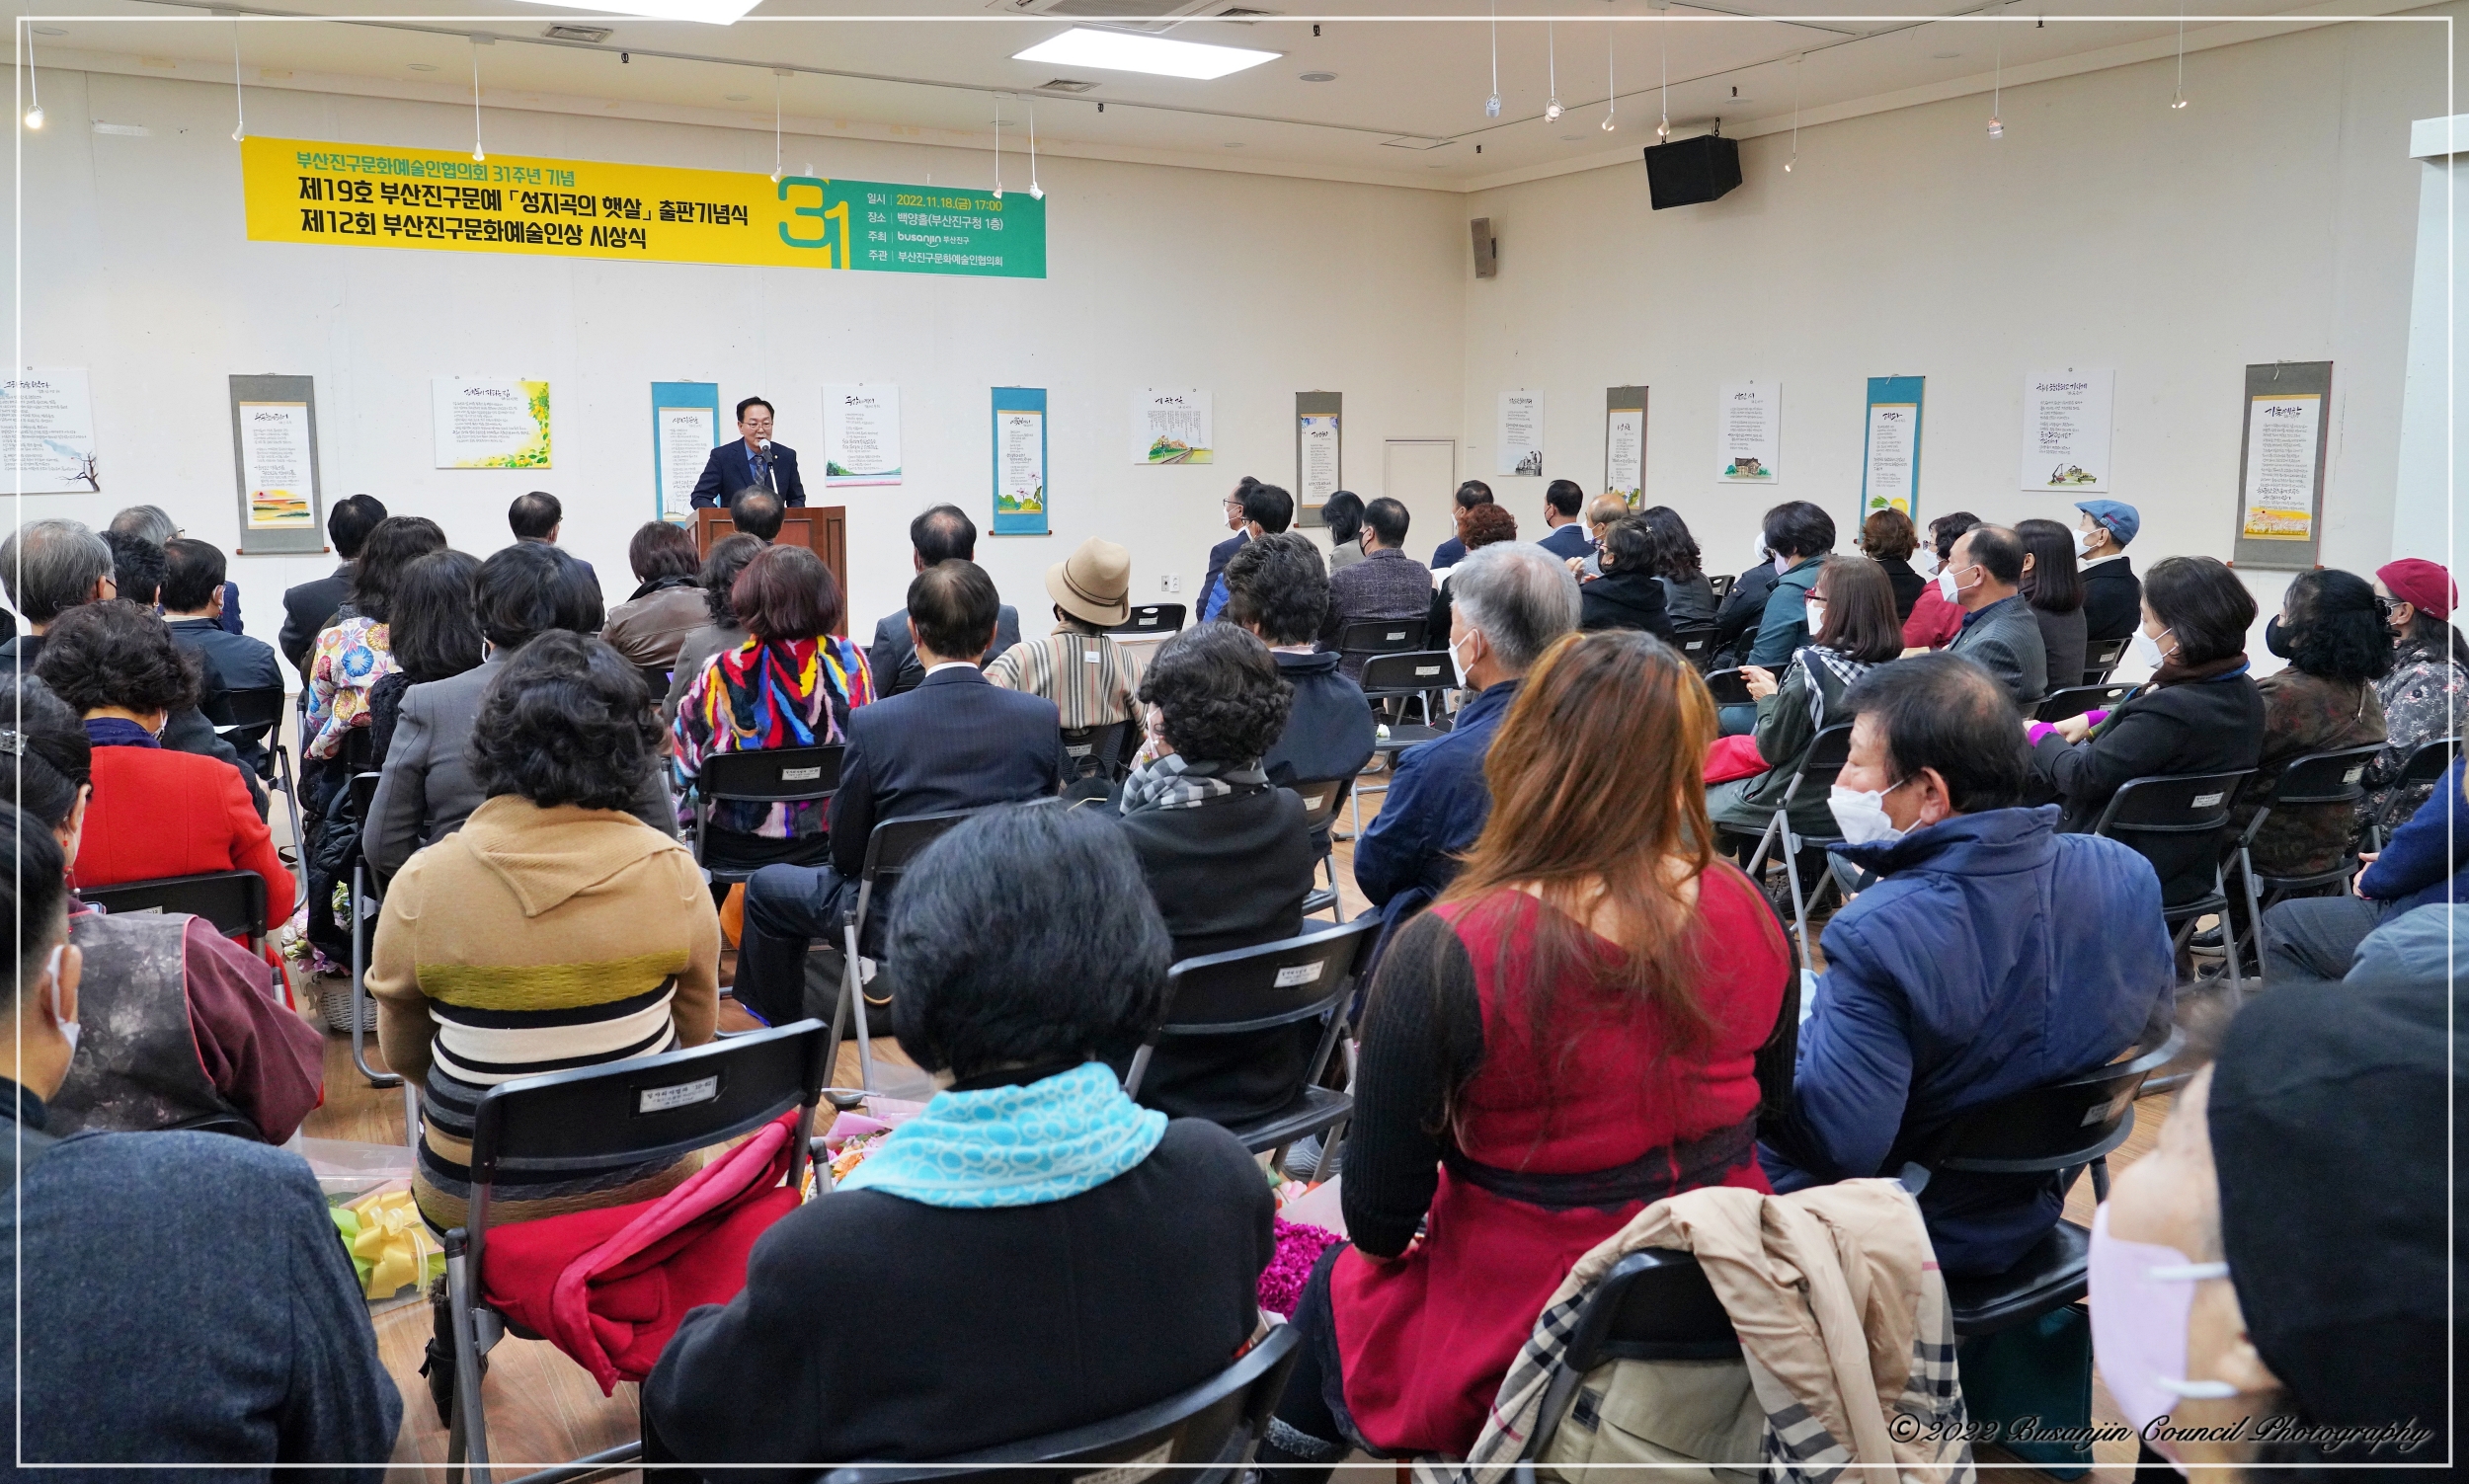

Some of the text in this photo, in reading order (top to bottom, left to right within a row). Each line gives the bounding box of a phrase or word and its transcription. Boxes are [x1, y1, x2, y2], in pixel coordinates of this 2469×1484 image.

[296, 151, 575, 187] 부산진구문화예술인협의회 31주년 기념
[298, 176, 373, 203] 제19호
[380, 182, 502, 211] 부산진구문예
[659, 199, 749, 226] 출판기념식
[867, 193, 1002, 212] 일시 2022.11.18.(금) 17:00
[300, 208, 646, 250] 제12회 부산진구문화예술인상 시상식
[778, 176, 850, 270] 31
[867, 211, 1003, 232] 장소 백양홀(부산진구청 1층)
[867, 230, 970, 245] 주최 busanjin 부산진구
[868, 250, 1003, 267] 주관 부산진구문화예술인협의회
